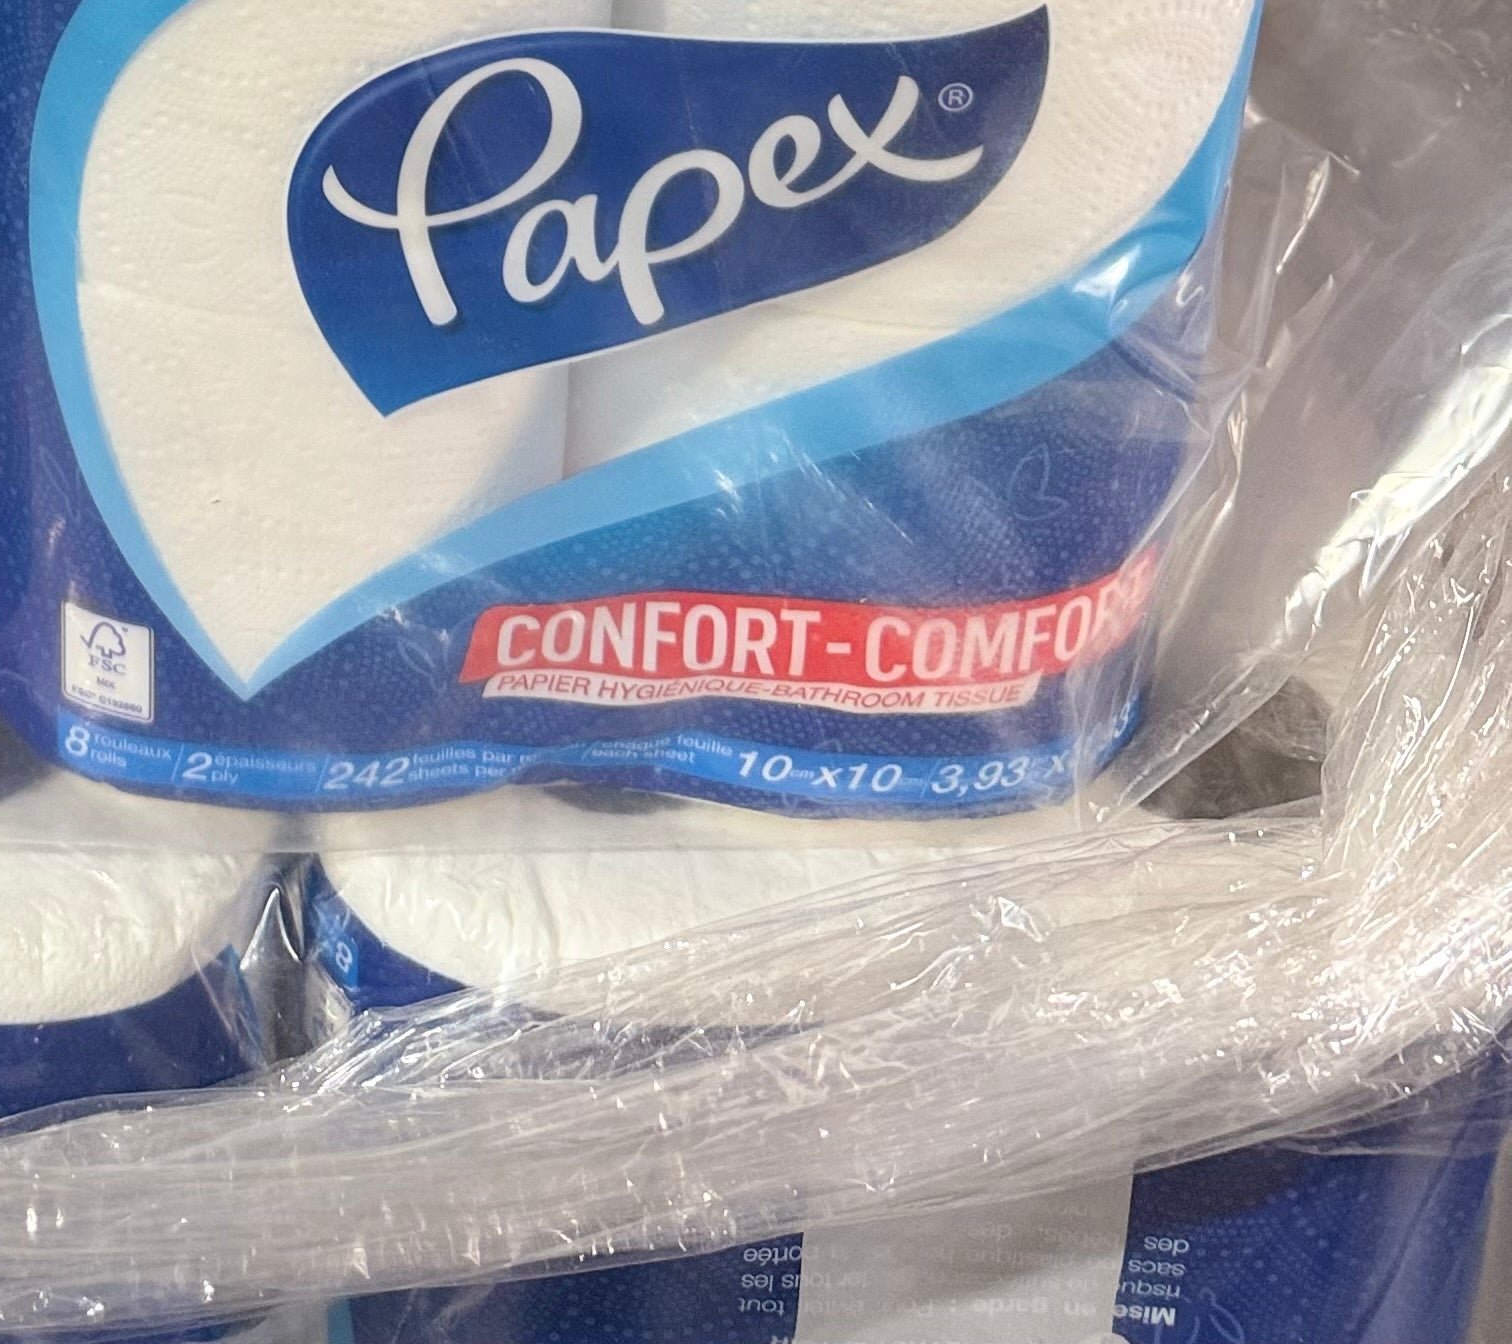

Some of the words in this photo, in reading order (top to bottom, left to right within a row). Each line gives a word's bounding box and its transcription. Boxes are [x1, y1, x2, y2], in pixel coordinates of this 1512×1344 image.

[496, 673, 590, 697] PAPIER
[933, 679, 1024, 706] TISSUE
[63, 724, 89, 758] 8
[91, 733, 172, 762] rouleaux
[89, 748, 128, 769] rolls
[181, 751, 213, 782] 2
[210, 768, 239, 785] ply
[323, 756, 410, 791] 242
[1143, 1235, 1190, 1253] des
[1127, 1258, 1186, 1276] sacs
[740, 1272, 774, 1290] les
[738, 1297, 786, 1316] tout
